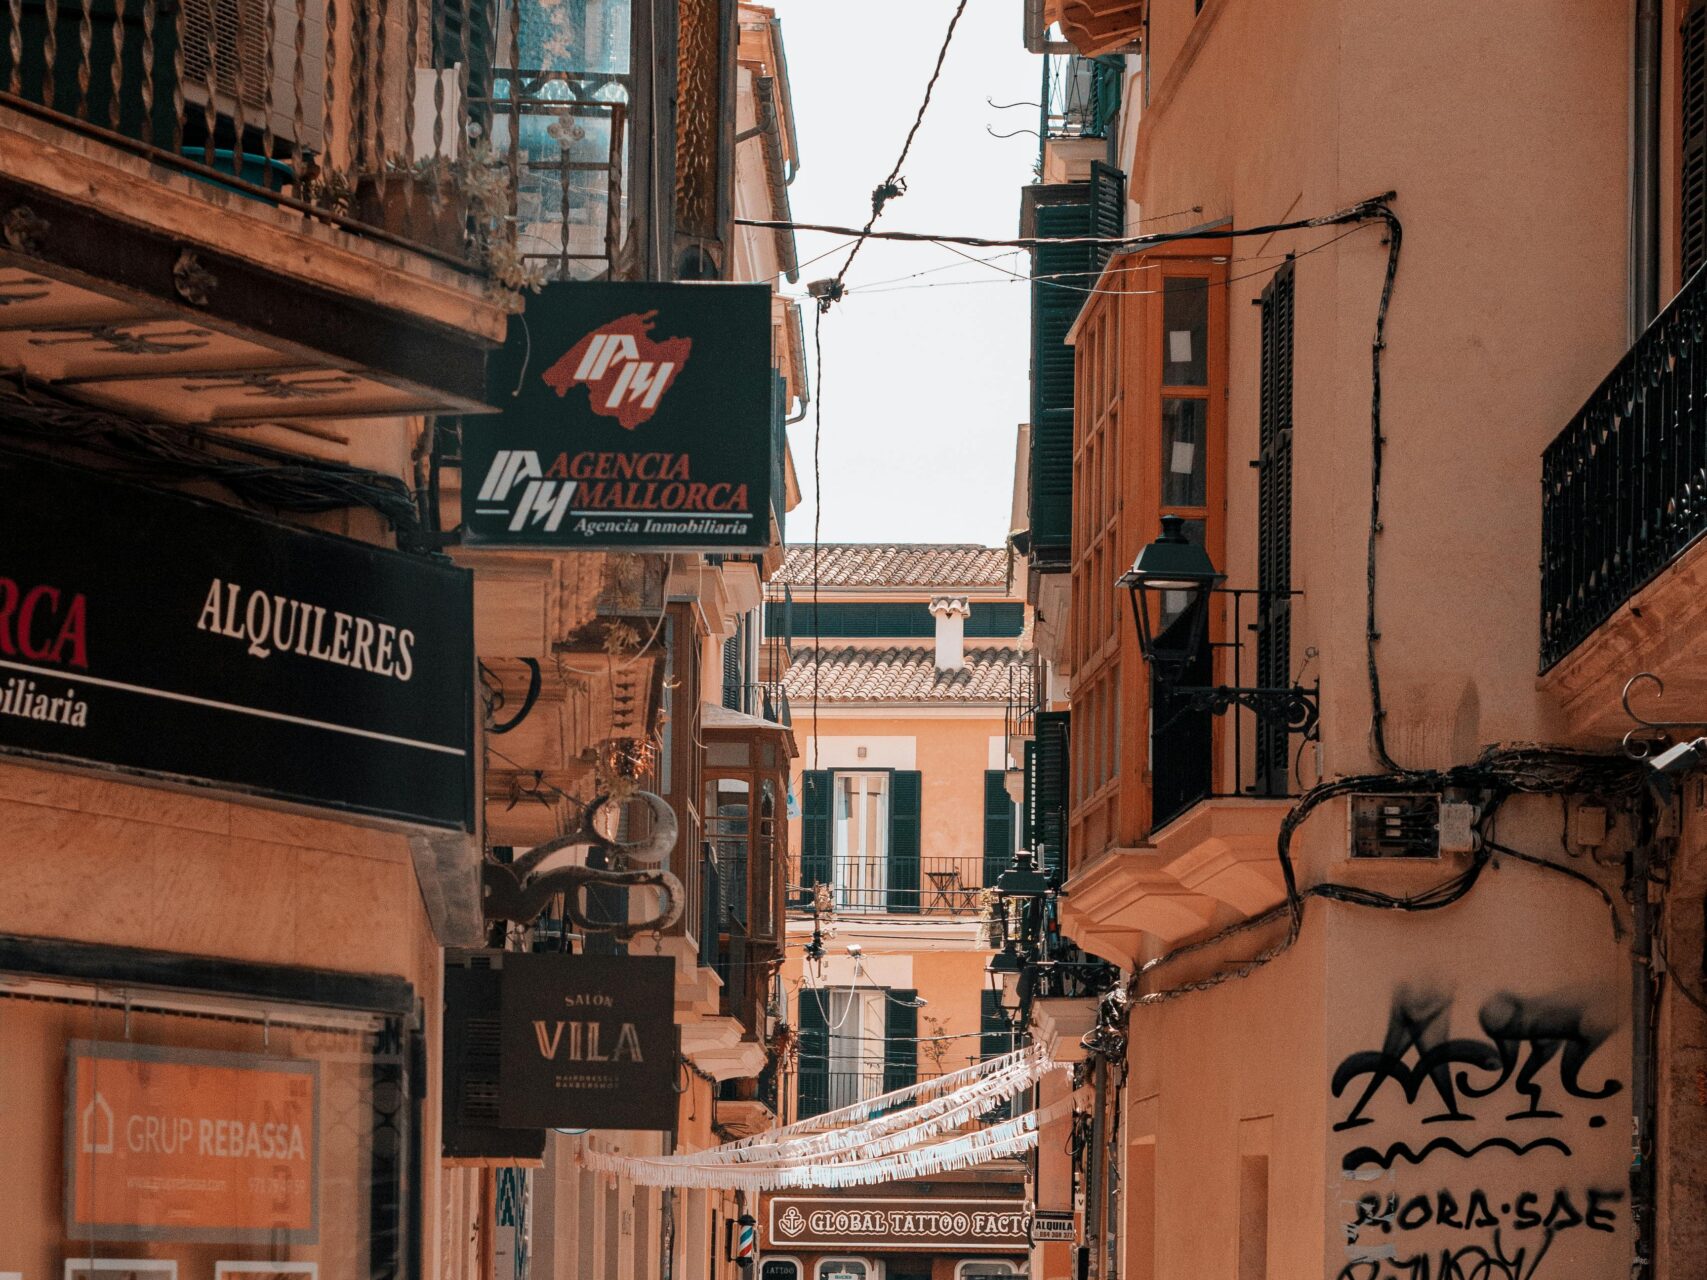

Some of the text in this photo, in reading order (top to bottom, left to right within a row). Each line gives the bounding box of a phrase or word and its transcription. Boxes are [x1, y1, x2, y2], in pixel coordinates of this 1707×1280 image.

[545, 452, 690, 480] AGENCIA
[572, 481, 749, 511] MALLORCA
[573, 518, 748, 537] Agencia Inmobiliaria
[197, 577, 415, 681] ALQUILERES
[0, 677, 88, 728] iliaria
[531, 1020, 644, 1063] VILA
[126, 1114, 306, 1161] GRUP REBASSA
[811, 1213, 886, 1233] GLOBAL
[890, 1213, 968, 1234] TATTOO
[1035, 1220, 1073, 1231] ALQUILA
